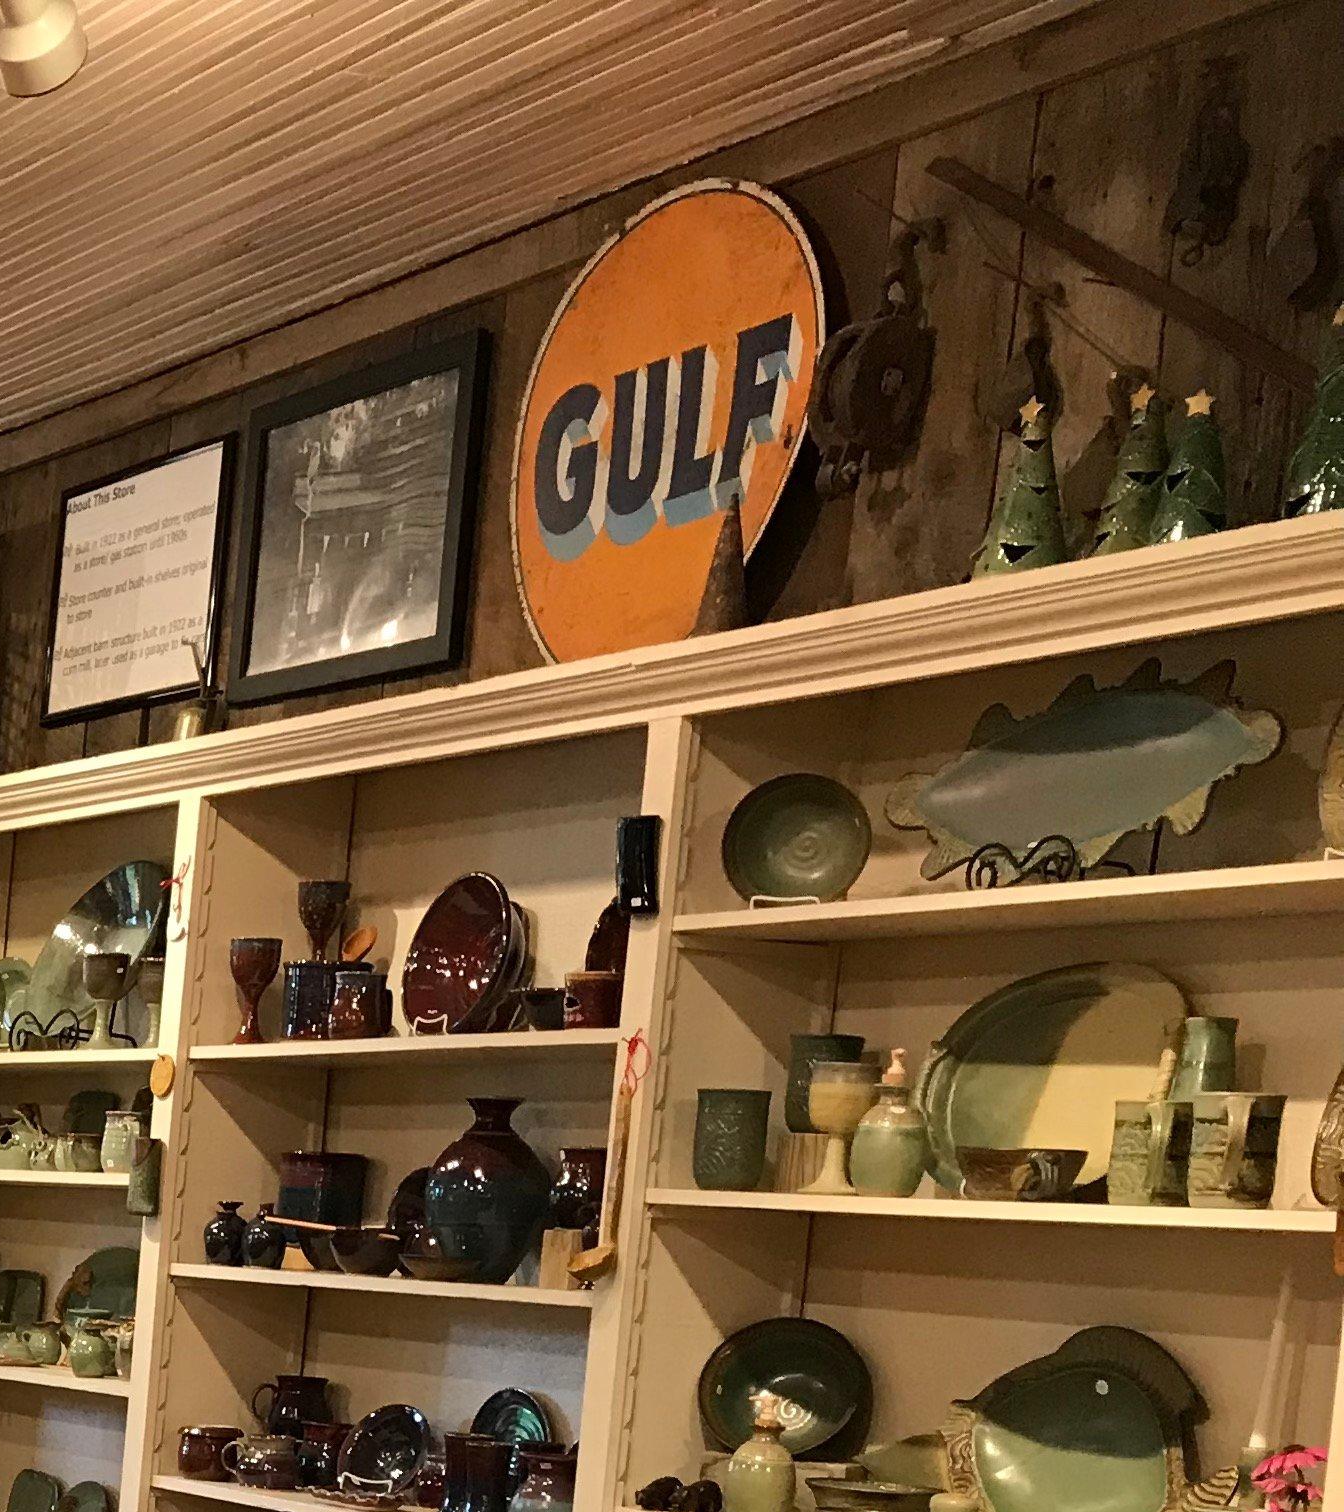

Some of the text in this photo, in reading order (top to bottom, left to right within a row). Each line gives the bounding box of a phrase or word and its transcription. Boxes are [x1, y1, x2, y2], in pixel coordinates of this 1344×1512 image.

[534, 312, 803, 562] GULF
[67, 481, 136, 515] About This Store
[133, 522, 160, 539] general
[183, 500, 215, 522] operated
[110, 550, 123, 564] gas
[123, 542, 148, 556] station
[150, 536, 166, 549] until
[68, 592, 87, 606] Store
[88, 586, 113, 601] counter
[114, 579, 127, 594] and
[154, 565, 181, 583] shelves
[181, 557, 208, 577] original
[75, 610, 92, 621] store
[64, 642, 93, 660] Adjacent
[94, 639, 109, 650] barn
[111, 632, 141, 647] structure
[143, 626, 159, 638] built
[112, 651, 128, 663] used
